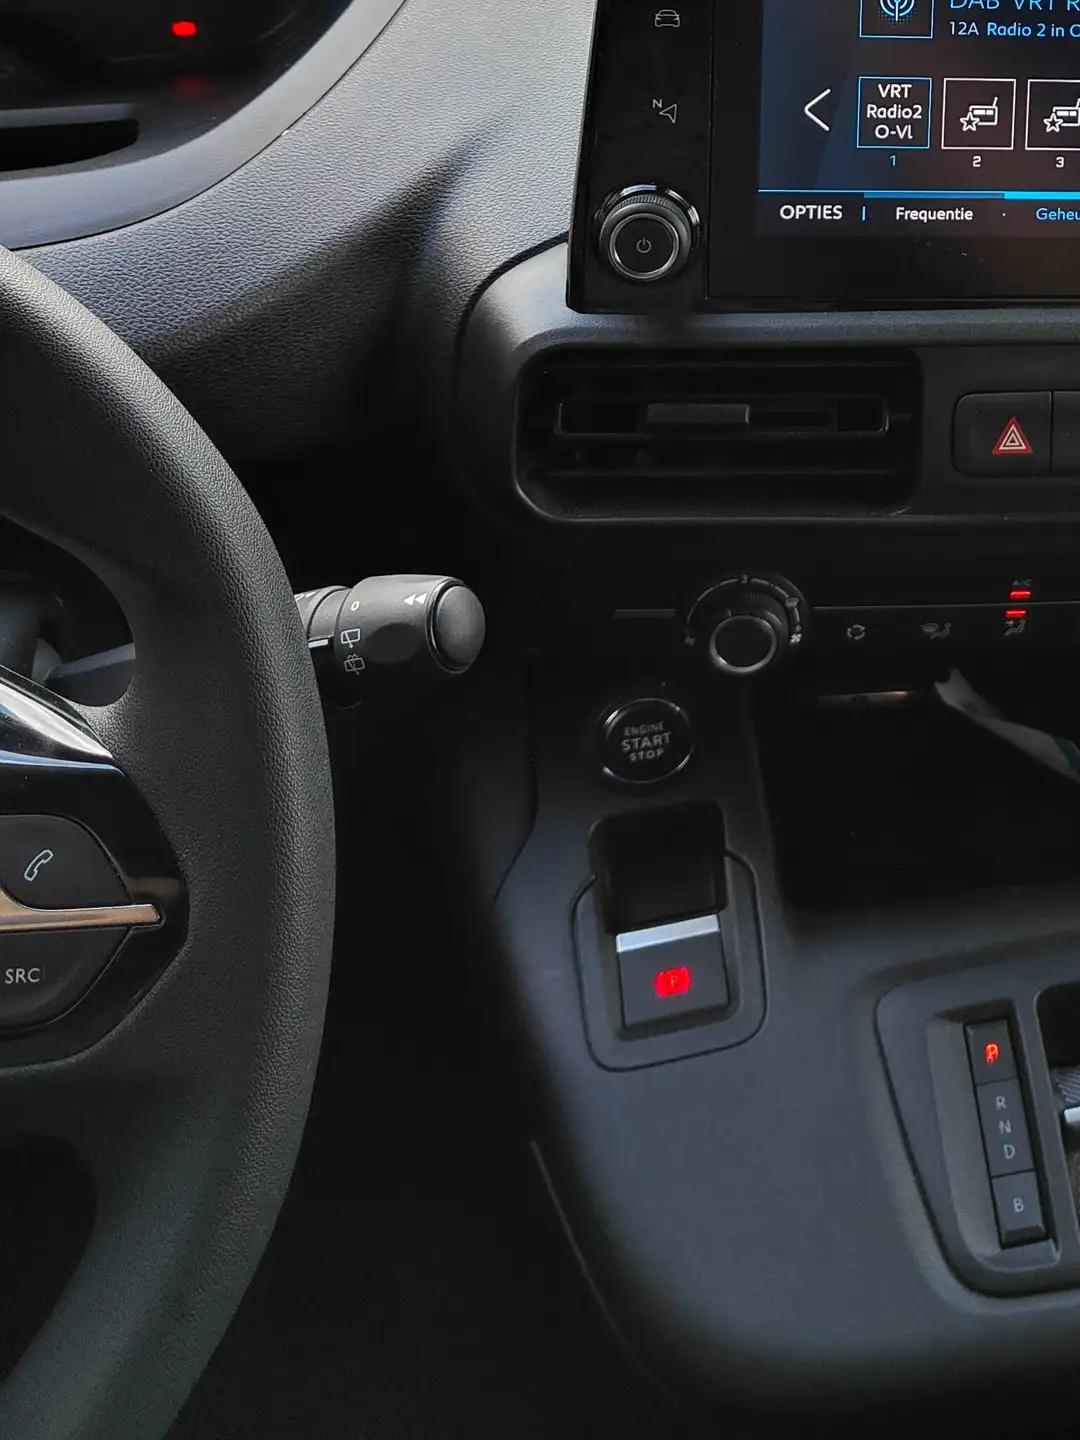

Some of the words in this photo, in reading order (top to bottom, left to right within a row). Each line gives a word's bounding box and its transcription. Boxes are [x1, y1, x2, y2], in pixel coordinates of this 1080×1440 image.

[950, 21, 980, 36] 12A
[987, 22, 1031, 37] Radio
[1037, 23, 1046, 37] 2
[1051, 23, 1064, 38] in
[878, 84, 912, 98] VRT
[866, 104, 922, 119] Radio2
[889, 155, 897, 167] 1
[972, 156, 982, 167] 2
[1056, 157, 1065, 169] 3
[779, 205, 843, 220] OPTIES
[896, 207, 973, 223] Frequentie
[623, 721, 664, 736] ENGINE
[621, 731, 671, 751] START
[630, 748, 664, 762] STOP
[5, 968, 40, 984] SRC
[995, 1096, 1007, 1109] R
[999, 1120, 1012, 1134] N
[1003, 1144, 1016, 1159] D
[1013, 1197, 1025, 1212] B
